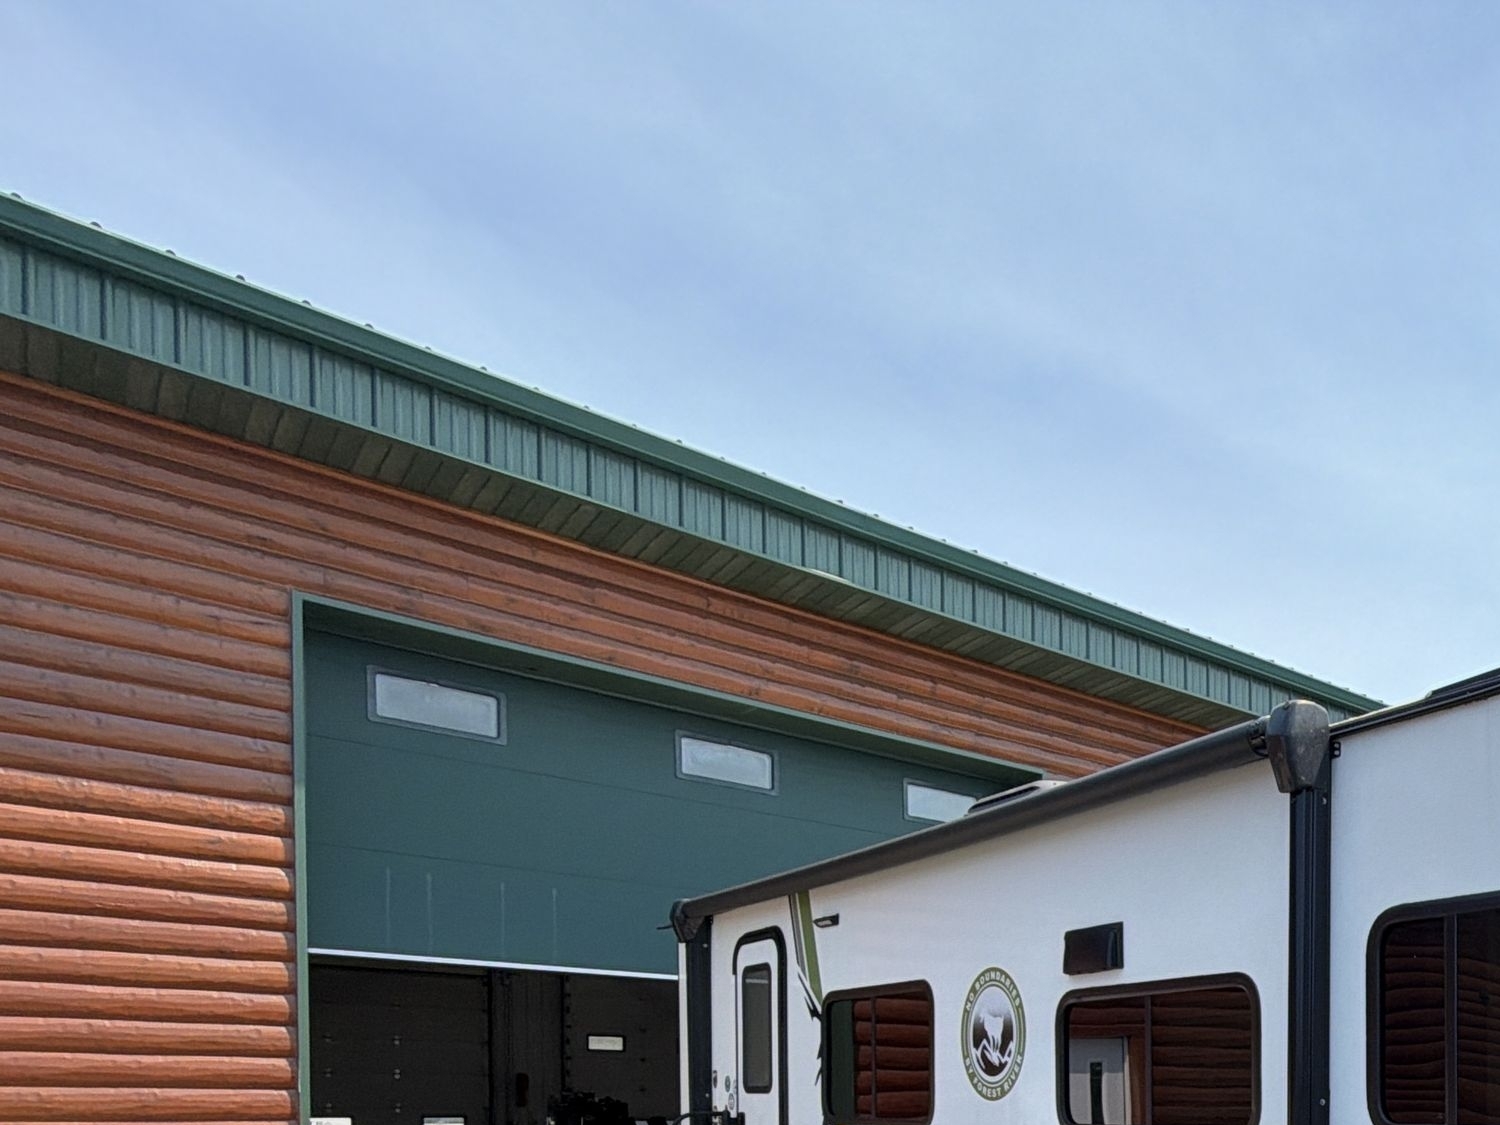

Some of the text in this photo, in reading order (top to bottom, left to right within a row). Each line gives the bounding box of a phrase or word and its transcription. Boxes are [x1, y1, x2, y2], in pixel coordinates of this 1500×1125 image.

[966, 970, 1021, 1011] NO BOUNDARIES
[965, 1055, 1023, 1098] BY FOREST RIVER
